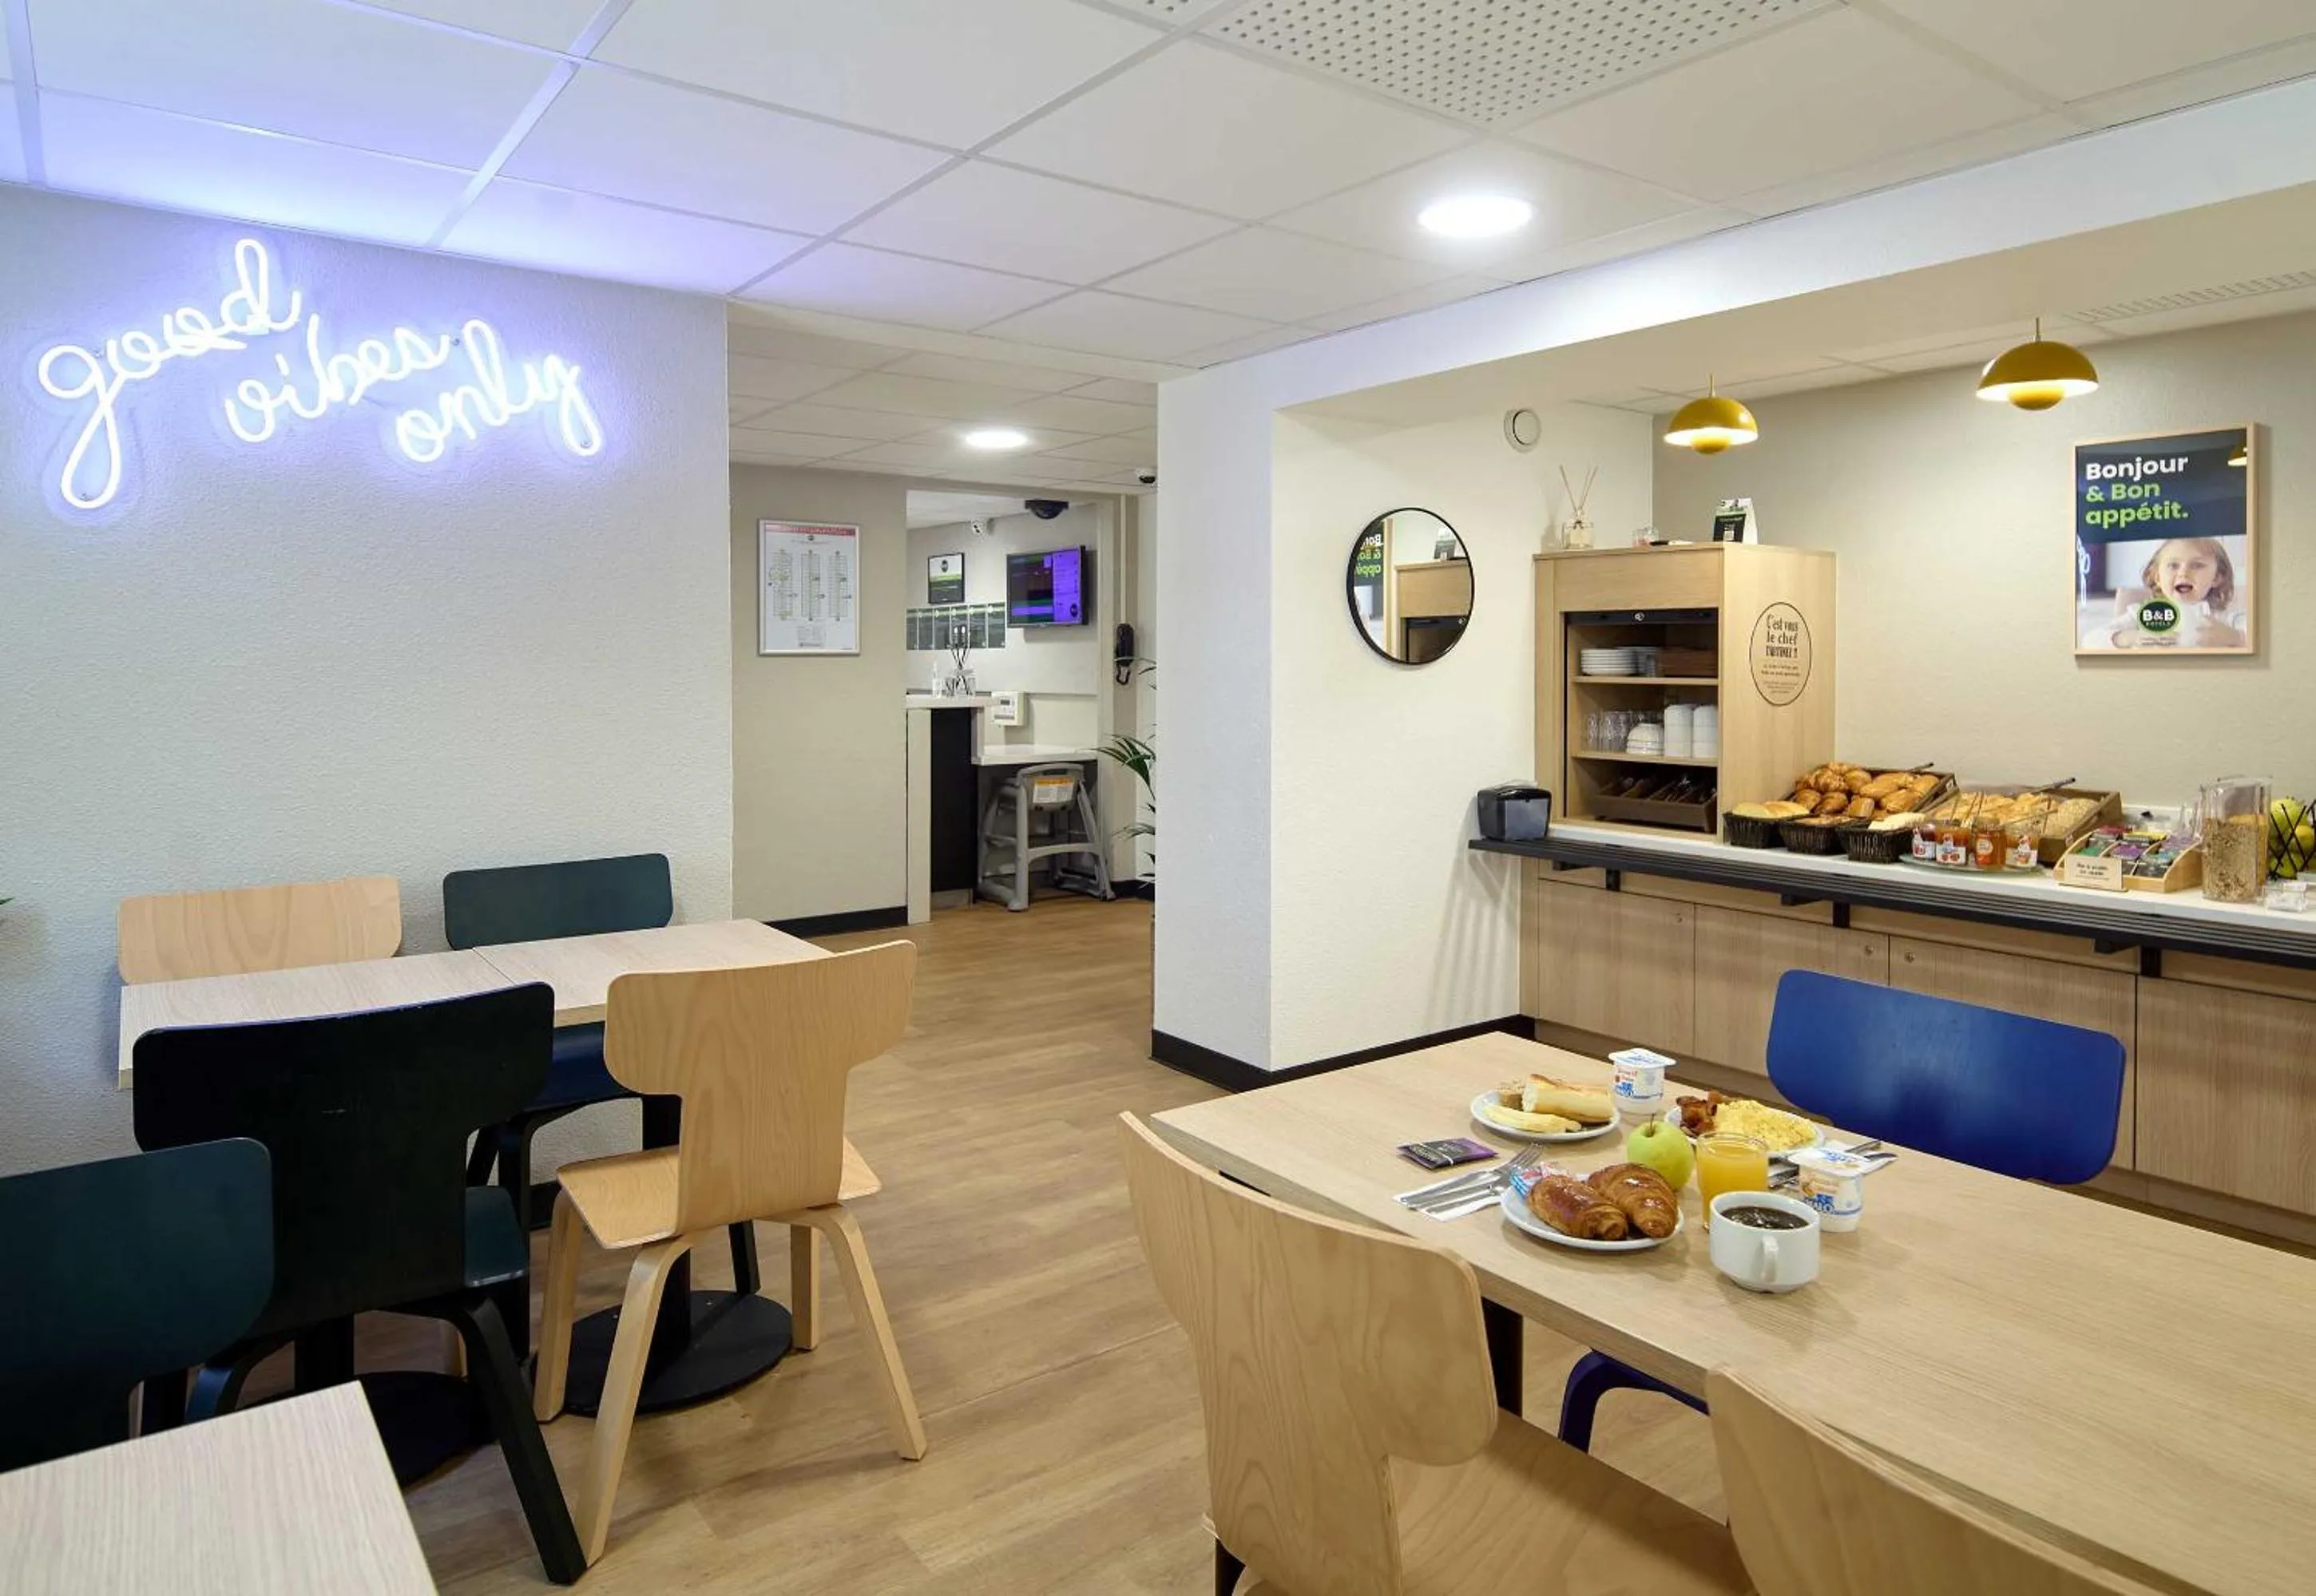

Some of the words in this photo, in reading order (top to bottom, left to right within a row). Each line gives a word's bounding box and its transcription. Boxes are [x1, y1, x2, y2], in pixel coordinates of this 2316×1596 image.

[38, 238, 302, 509] good
[224, 313, 452, 443] vibes
[396, 319, 601, 462] only
[2085, 456, 2189, 481] Bonjour
[2085, 485, 2105, 502] &
[2111, 482, 2161, 501] Bon
[2085, 500, 2189, 529] appétit.
[2142, 609, 2175, 622] B&B
[1767, 630, 1775, 644] le
[1778, 632, 1798, 646] chef
